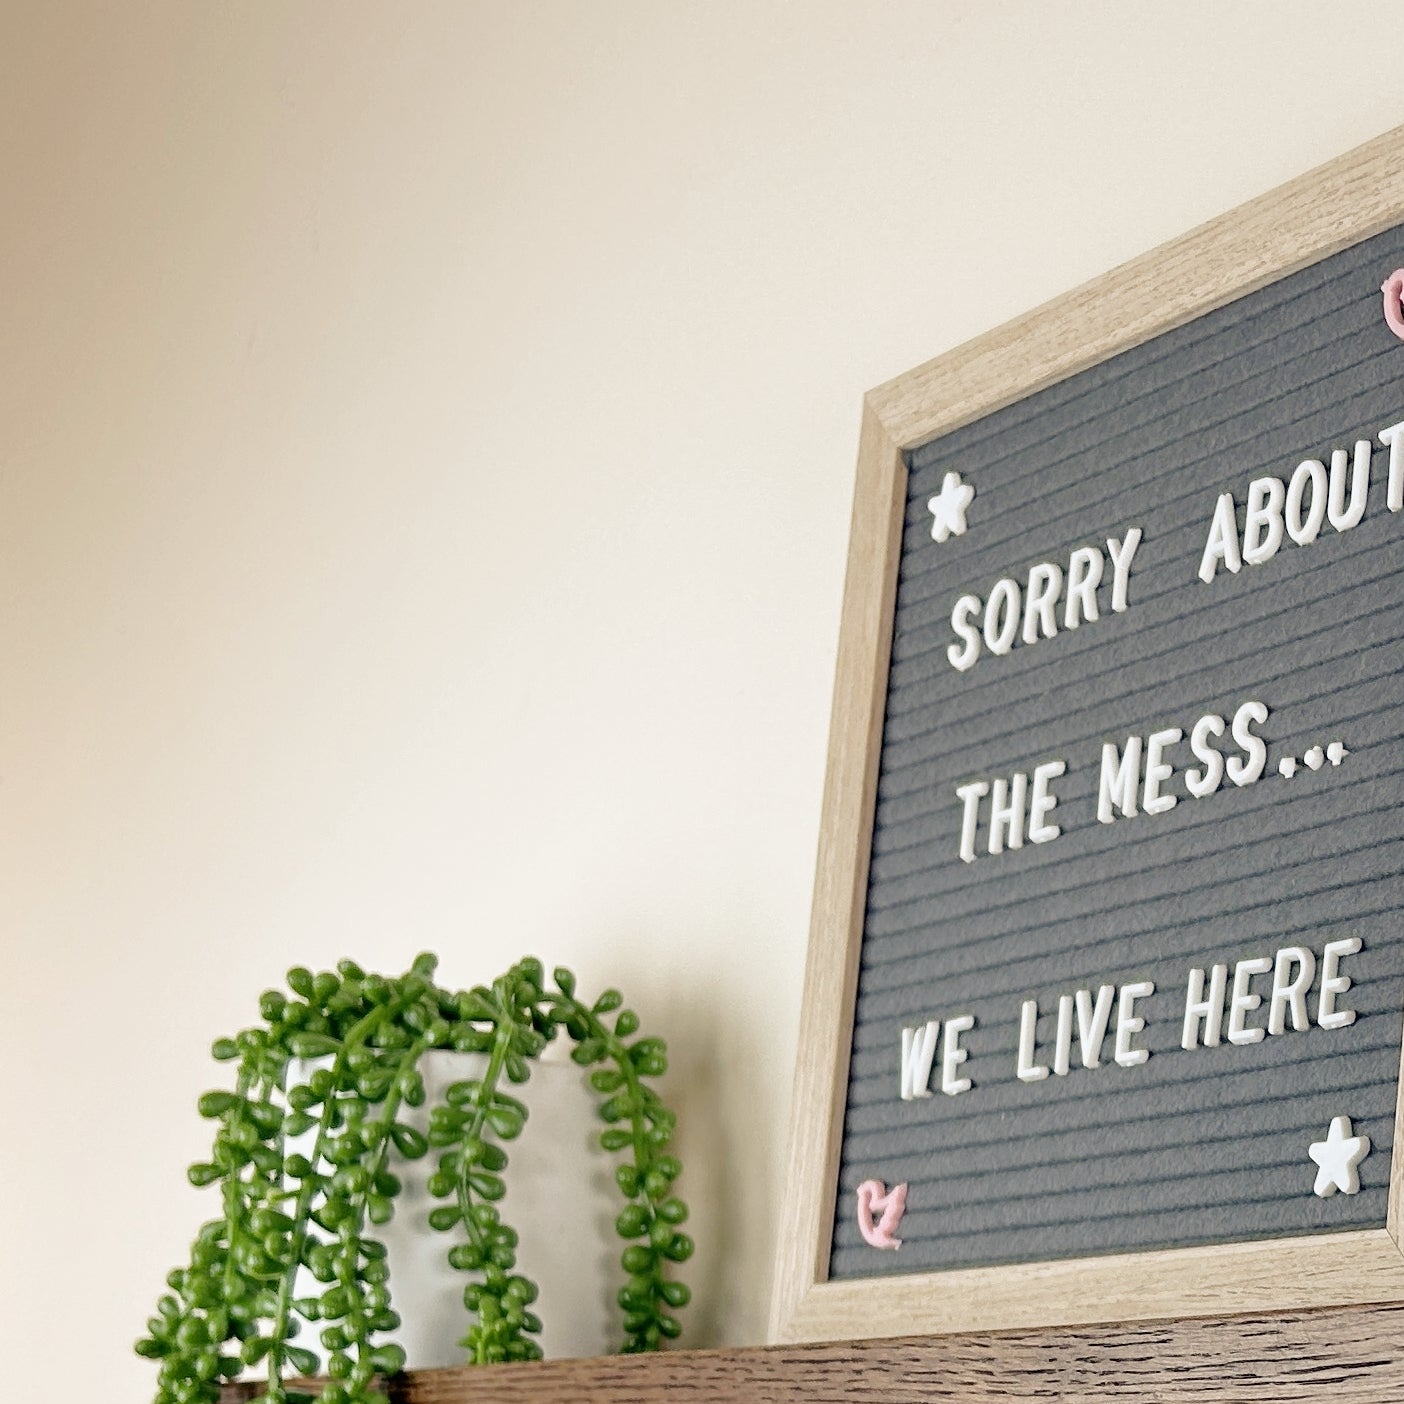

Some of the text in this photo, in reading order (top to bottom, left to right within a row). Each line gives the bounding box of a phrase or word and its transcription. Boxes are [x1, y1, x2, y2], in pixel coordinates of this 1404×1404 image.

[945, 526, 1143, 672] SORRY
[954, 700, 1350, 865] THE MESS...
[899, 936, 1362, 1102] WE LIVE HERE
